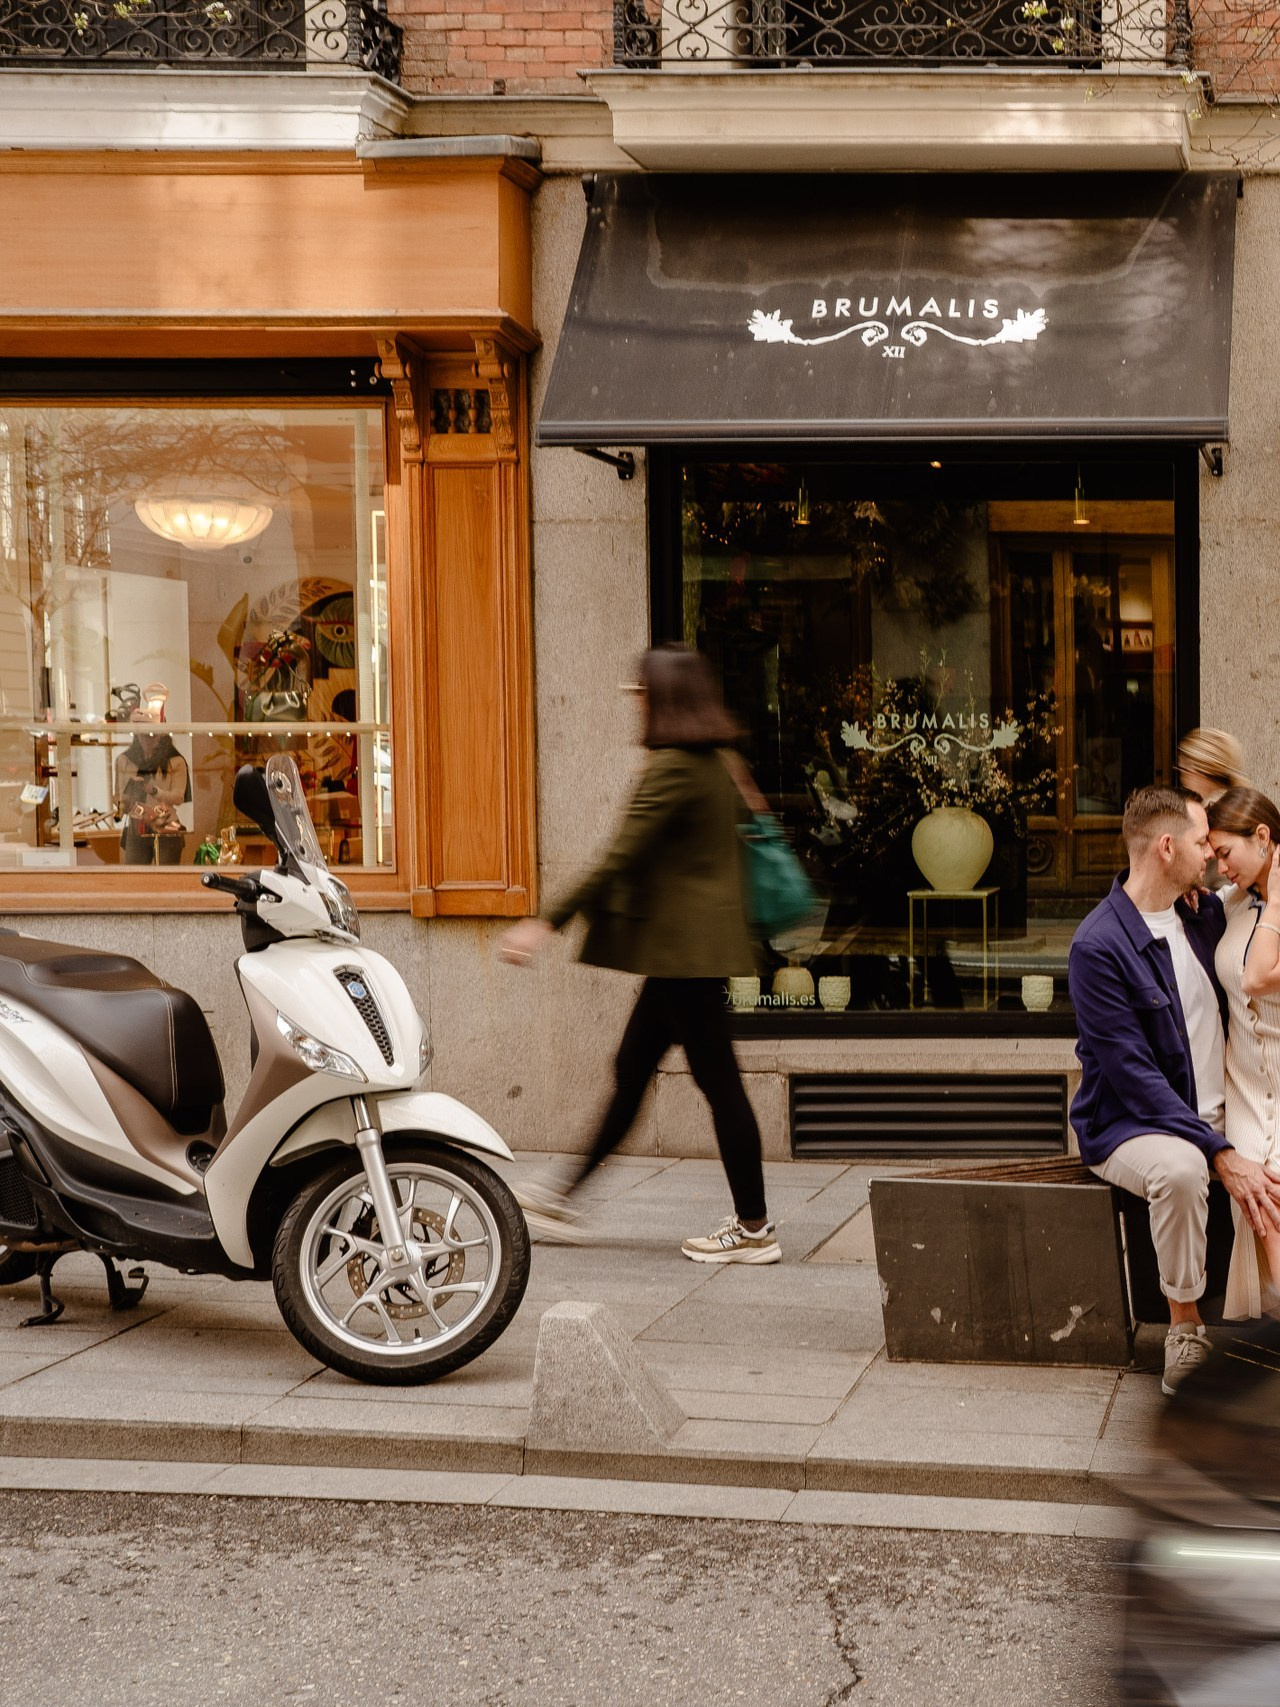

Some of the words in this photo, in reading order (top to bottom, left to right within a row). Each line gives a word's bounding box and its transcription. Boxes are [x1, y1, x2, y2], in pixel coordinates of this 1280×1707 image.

[812, 296, 999, 318] BRUMALIS
[882, 345, 905, 358] XII
[877, 712, 989, 729] BRUMALIS
[732, 990, 816, 1006] brumalis.es
